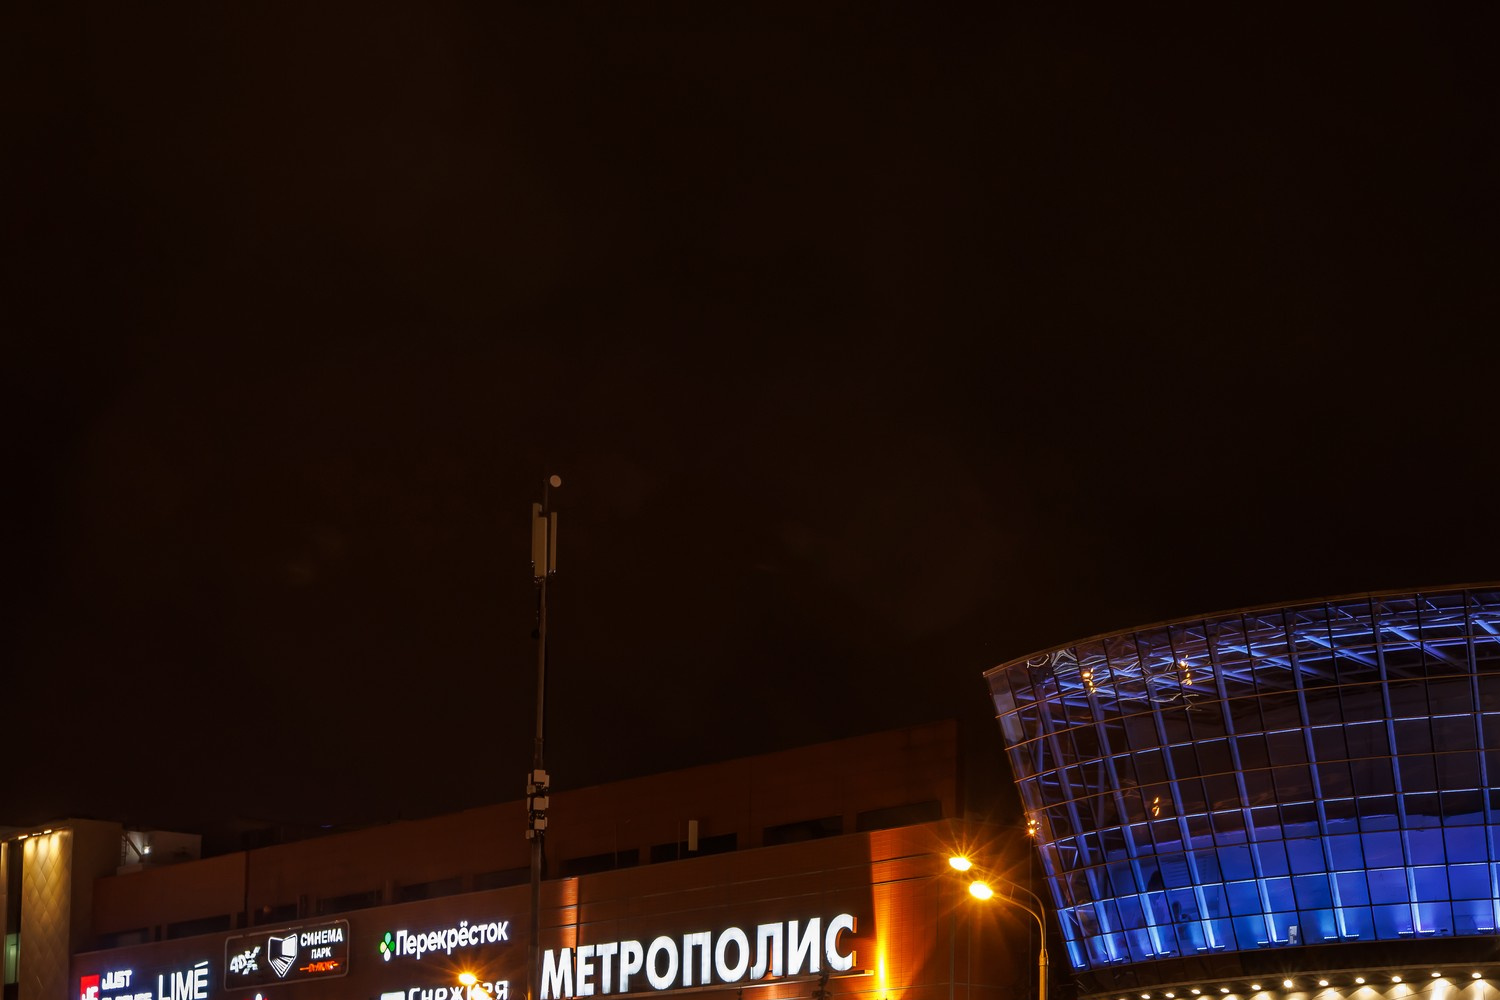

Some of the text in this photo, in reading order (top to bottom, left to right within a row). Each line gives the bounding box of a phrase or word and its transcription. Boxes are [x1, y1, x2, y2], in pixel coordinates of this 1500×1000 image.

[300, 928, 343, 947] СИНЕМА
[396, 921, 509, 960] Перекрёсток
[311, 947, 331, 959] ПАРК
[540, 913, 857, 1000] МЕТРОПОЛИС
[101, 970, 132, 990] JUST
